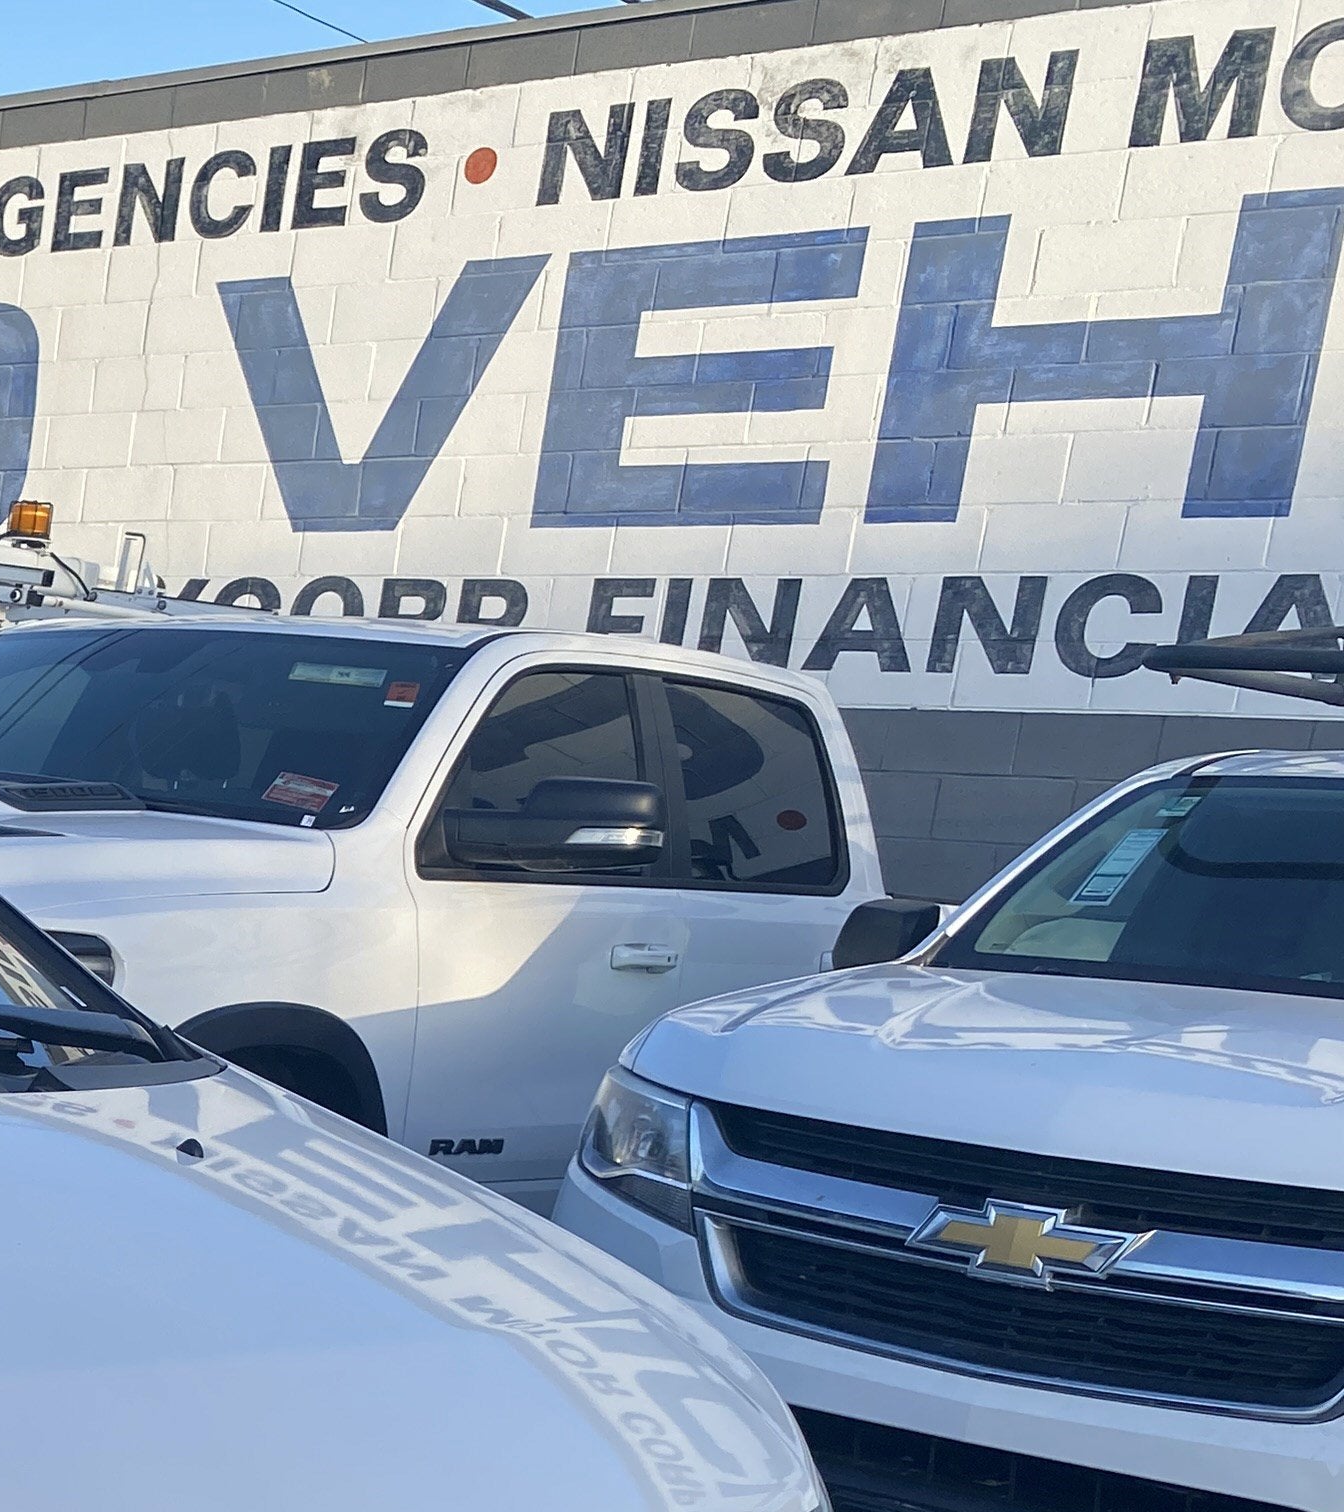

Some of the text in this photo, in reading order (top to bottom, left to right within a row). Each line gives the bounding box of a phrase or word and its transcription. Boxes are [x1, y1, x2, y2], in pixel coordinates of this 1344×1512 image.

[535, 48, 1081, 206] NISSAN
[216, 187, 1344, 534] VEH
[428, 1138, 505, 1156] RAM
